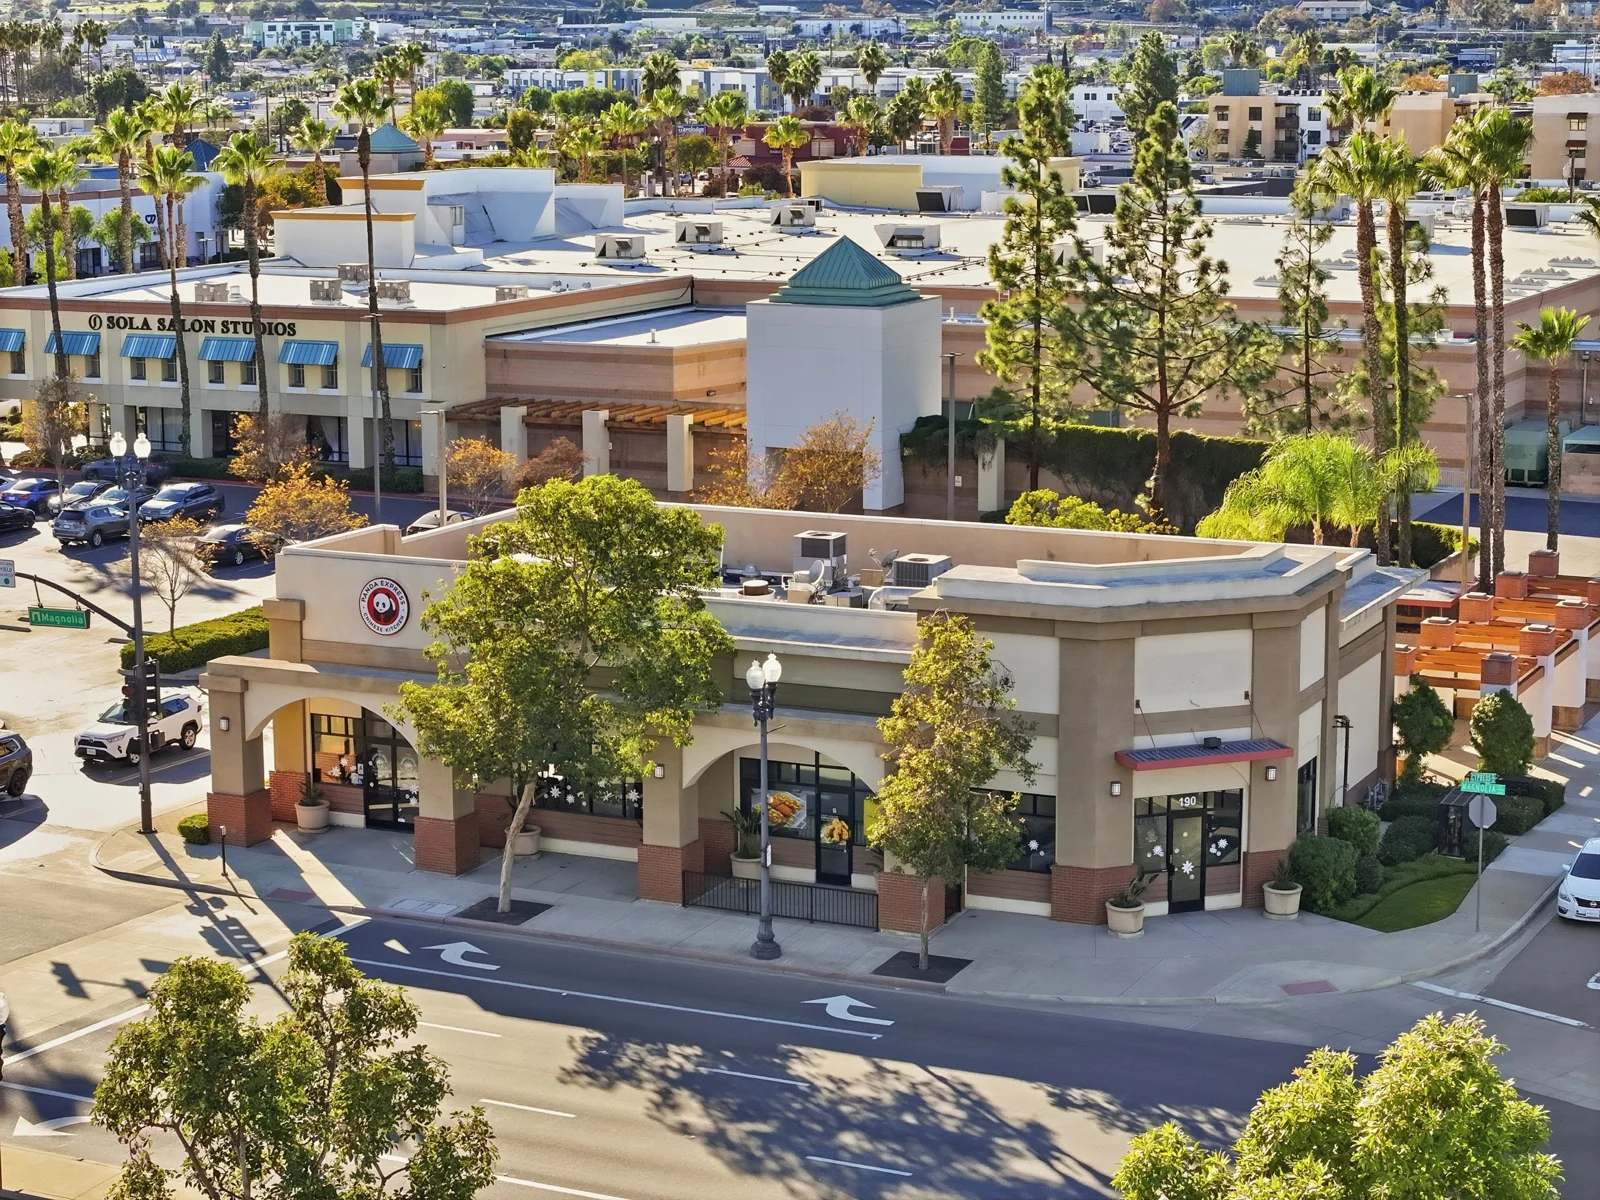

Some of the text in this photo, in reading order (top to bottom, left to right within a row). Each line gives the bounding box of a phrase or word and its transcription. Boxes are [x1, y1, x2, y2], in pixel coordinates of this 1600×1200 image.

[107, 315, 296, 336] SOLA SALON STUDIOS
[361, 580, 406, 605] PANDA EXPRESS
[41, 612, 84, 625] Magnolia
[363, 612, 404, 632] CHINESE KITCHEN
[1471, 773, 1491, 782] CYPRESS
[1461, 781, 1496, 793] MAGNOLIA
[1178, 795, 1197, 807] 190
